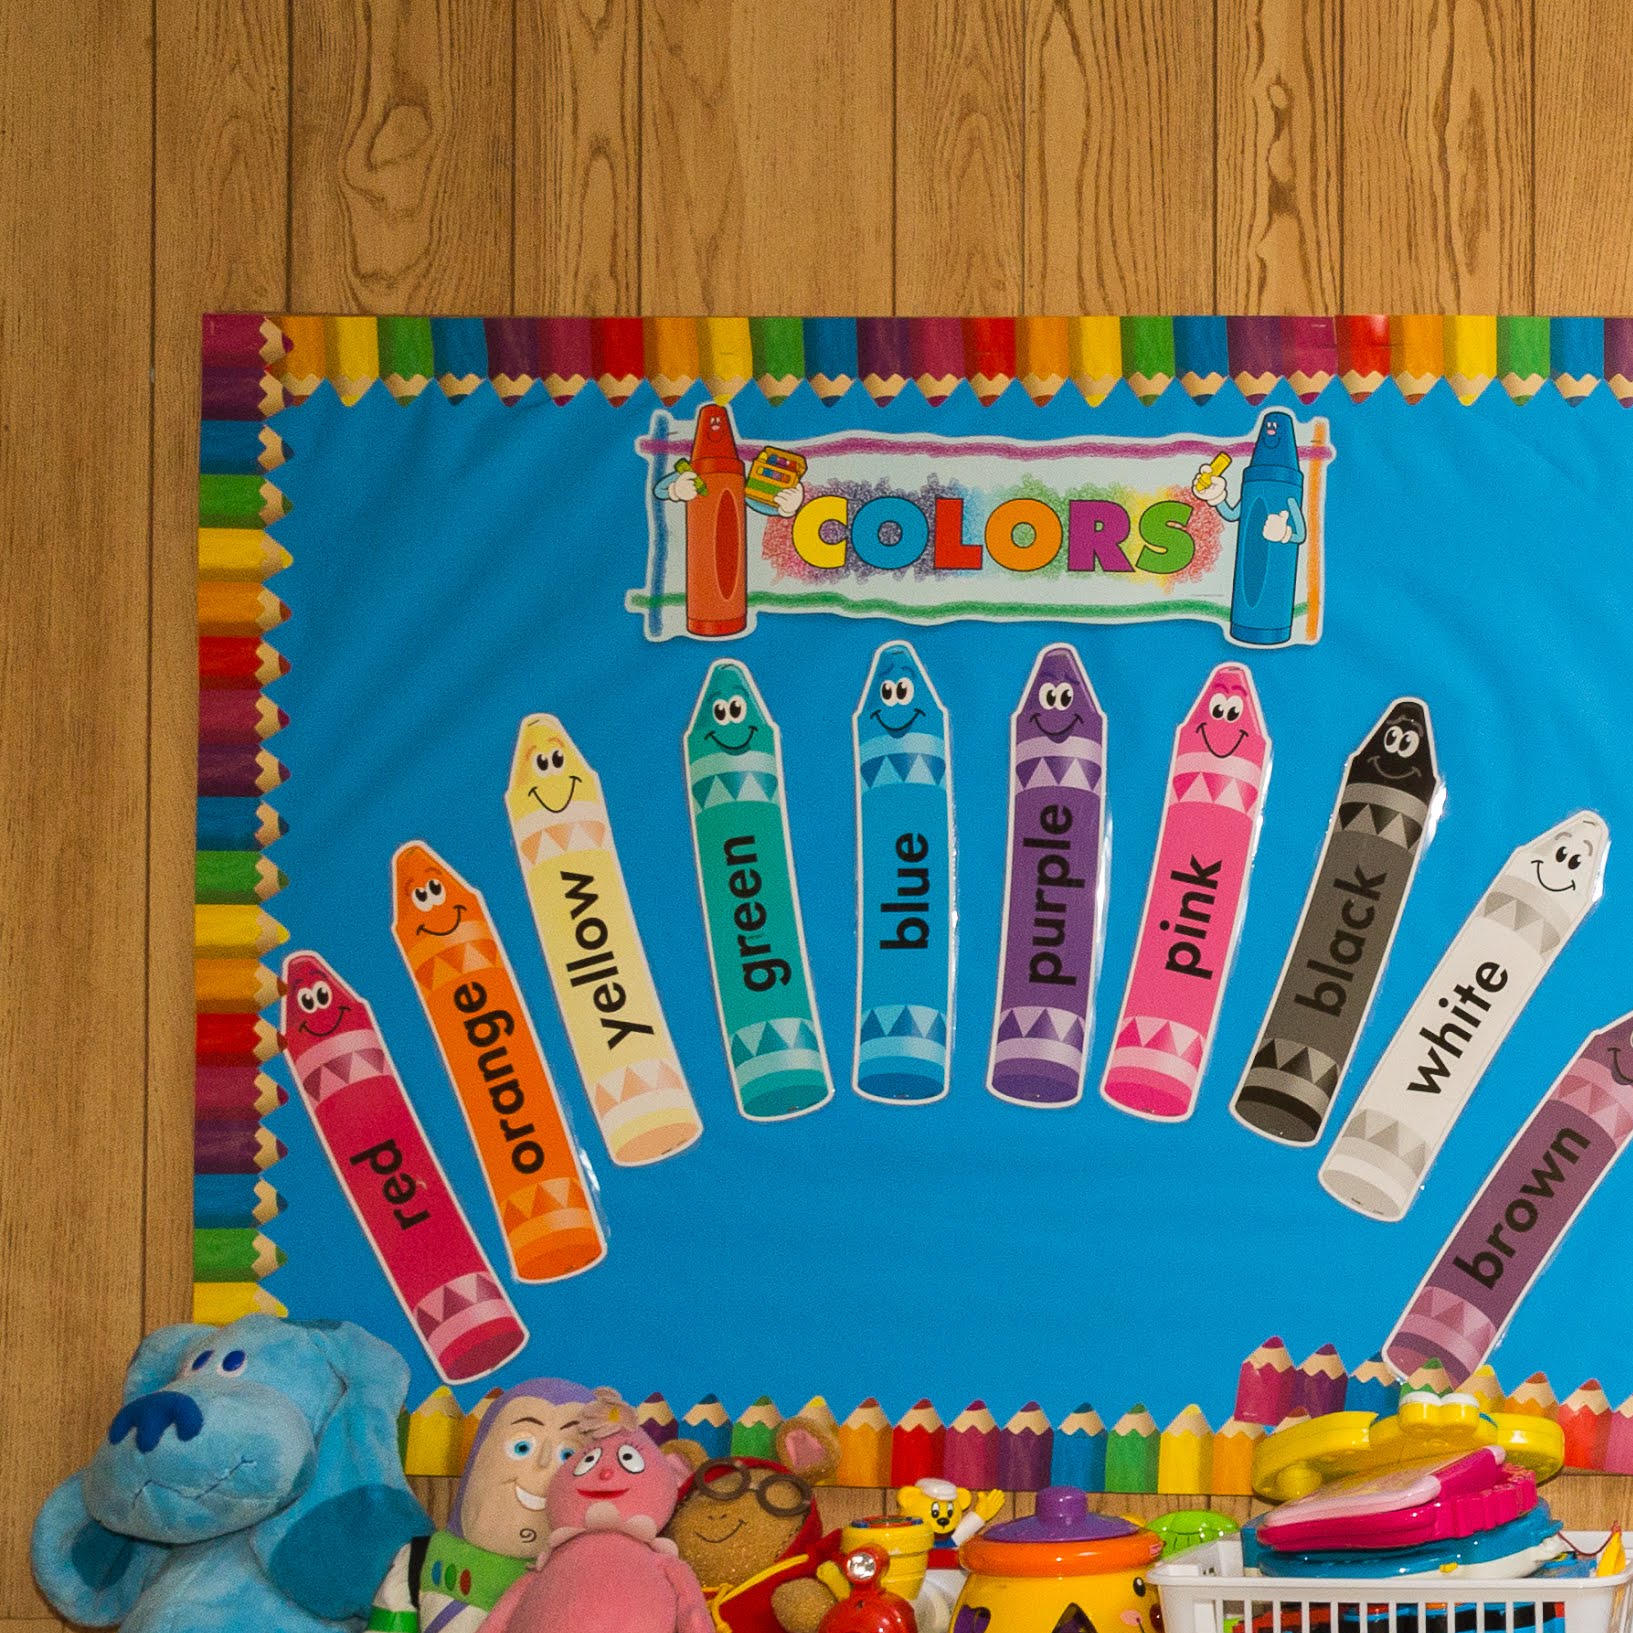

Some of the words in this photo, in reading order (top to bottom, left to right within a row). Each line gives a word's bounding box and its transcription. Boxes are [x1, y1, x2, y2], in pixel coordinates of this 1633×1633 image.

[792, 496, 1194, 573] COLORS
[560, 871, 655, 1050] yellow
[724, 834, 792, 993] green
[880, 832, 929, 949] blue
[1023, 804, 1085, 986] purple
[1159, 855, 1223, 980] pink
[1294, 864, 1388, 1017] black
[453, 980, 545, 1176] orange
[1408, 959, 1509, 1098] white
[349, 1139, 431, 1229] red
[1453, 1126, 1591, 1290] brown
